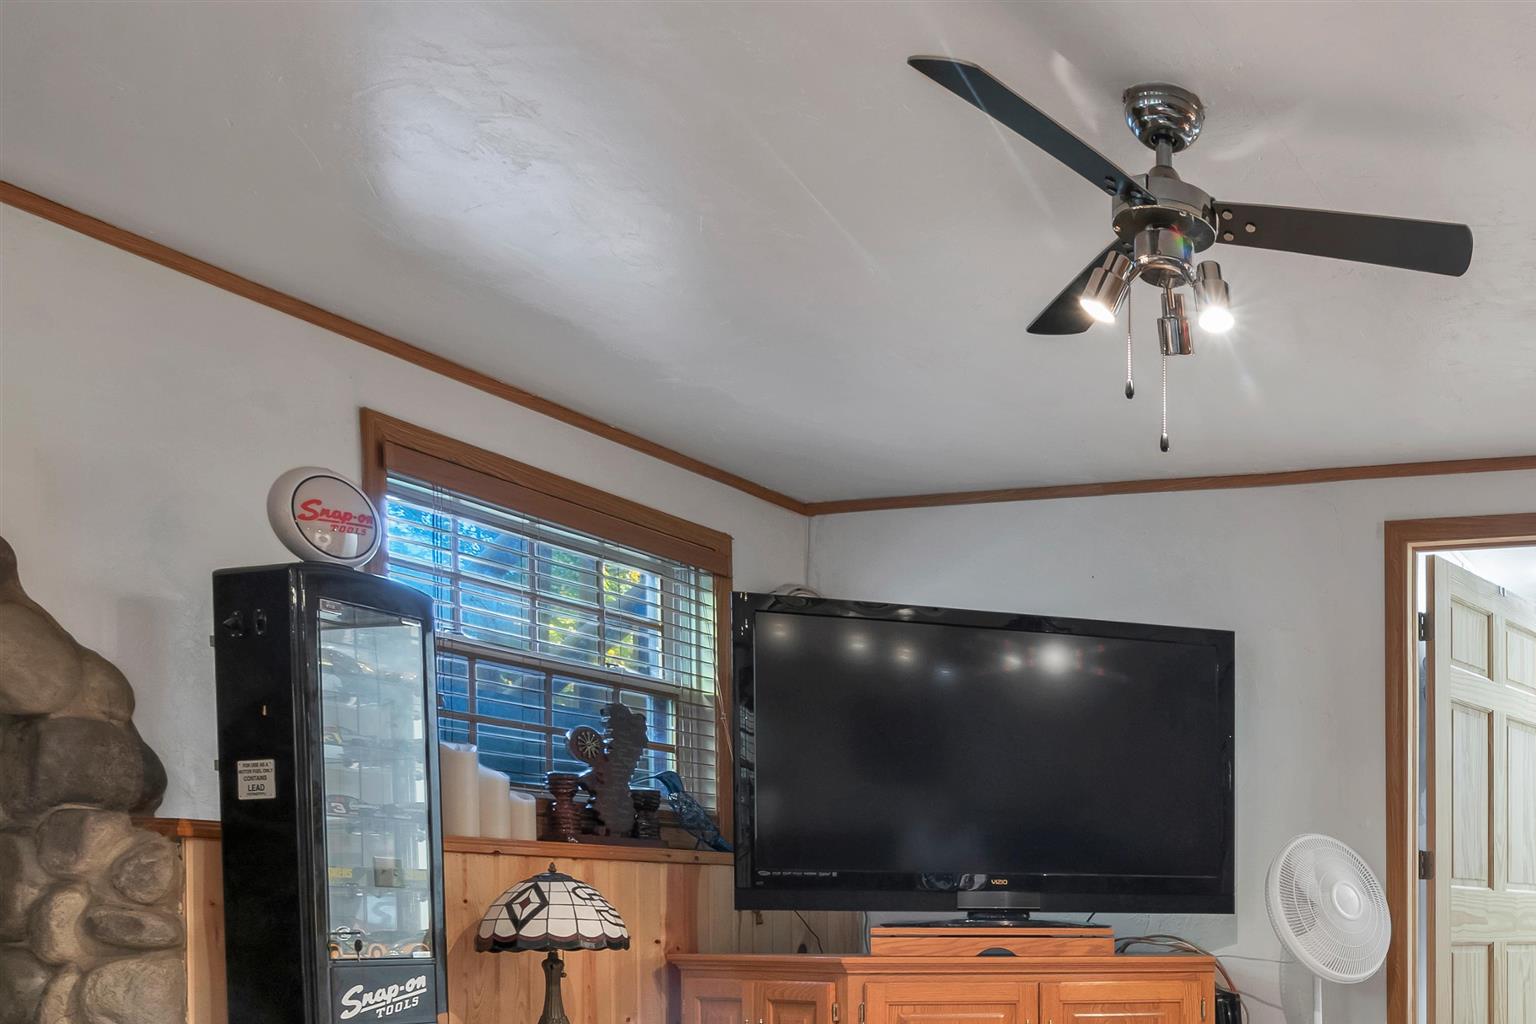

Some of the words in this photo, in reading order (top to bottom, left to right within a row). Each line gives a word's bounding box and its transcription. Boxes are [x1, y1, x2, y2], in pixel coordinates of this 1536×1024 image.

[297, 499, 373, 525] Snap-on
[329, 524, 367, 536] TOOLS
[247, 783, 265, 791] LEAD
[341, 975, 427, 1019] Snap-on
[376, 996, 419, 1019] TOOLS
